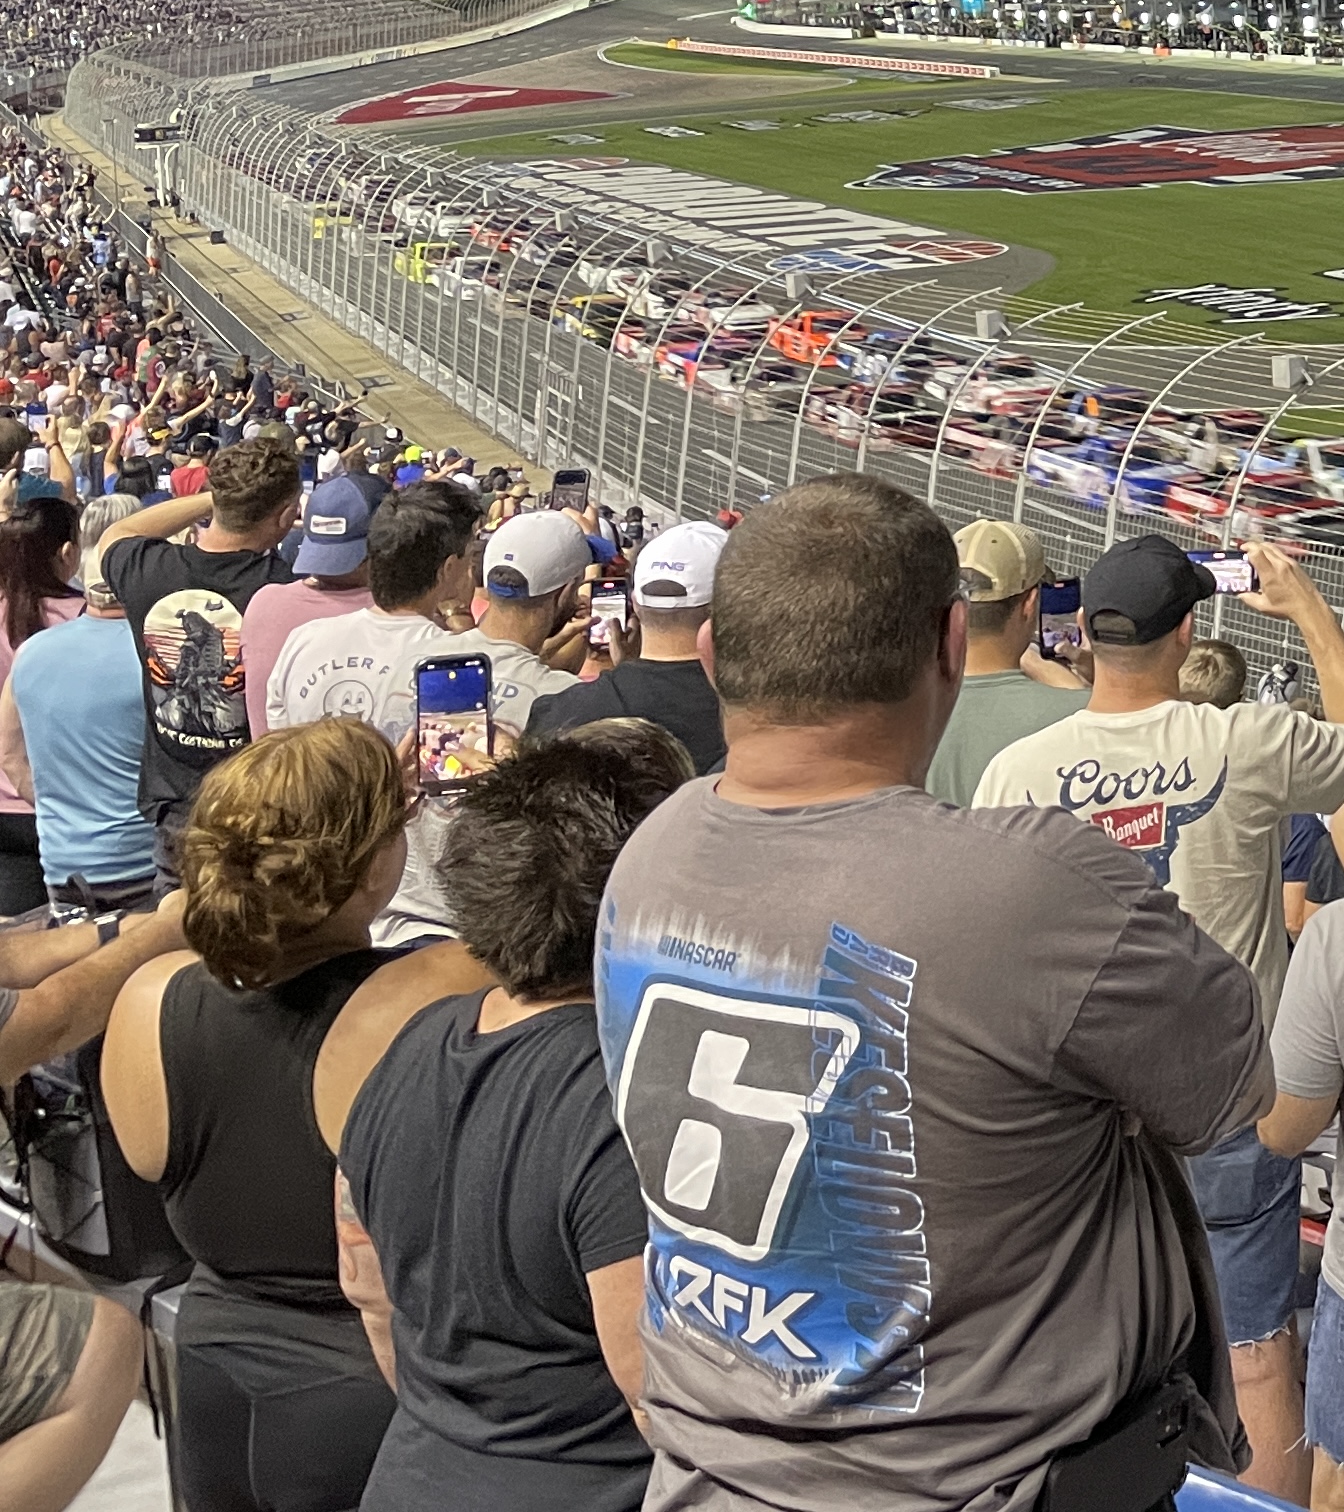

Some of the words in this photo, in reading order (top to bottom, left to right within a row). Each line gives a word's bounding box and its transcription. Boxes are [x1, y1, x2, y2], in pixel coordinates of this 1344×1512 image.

[651, 561, 685, 572] PING
[1056, 755, 1197, 811] Coors
[1102, 806, 1160, 842] Banquet
[672, 935, 737, 973] NASCAR
[617, 982, 861, 1263] 6
[669, 1255, 817, 1359] RFK
